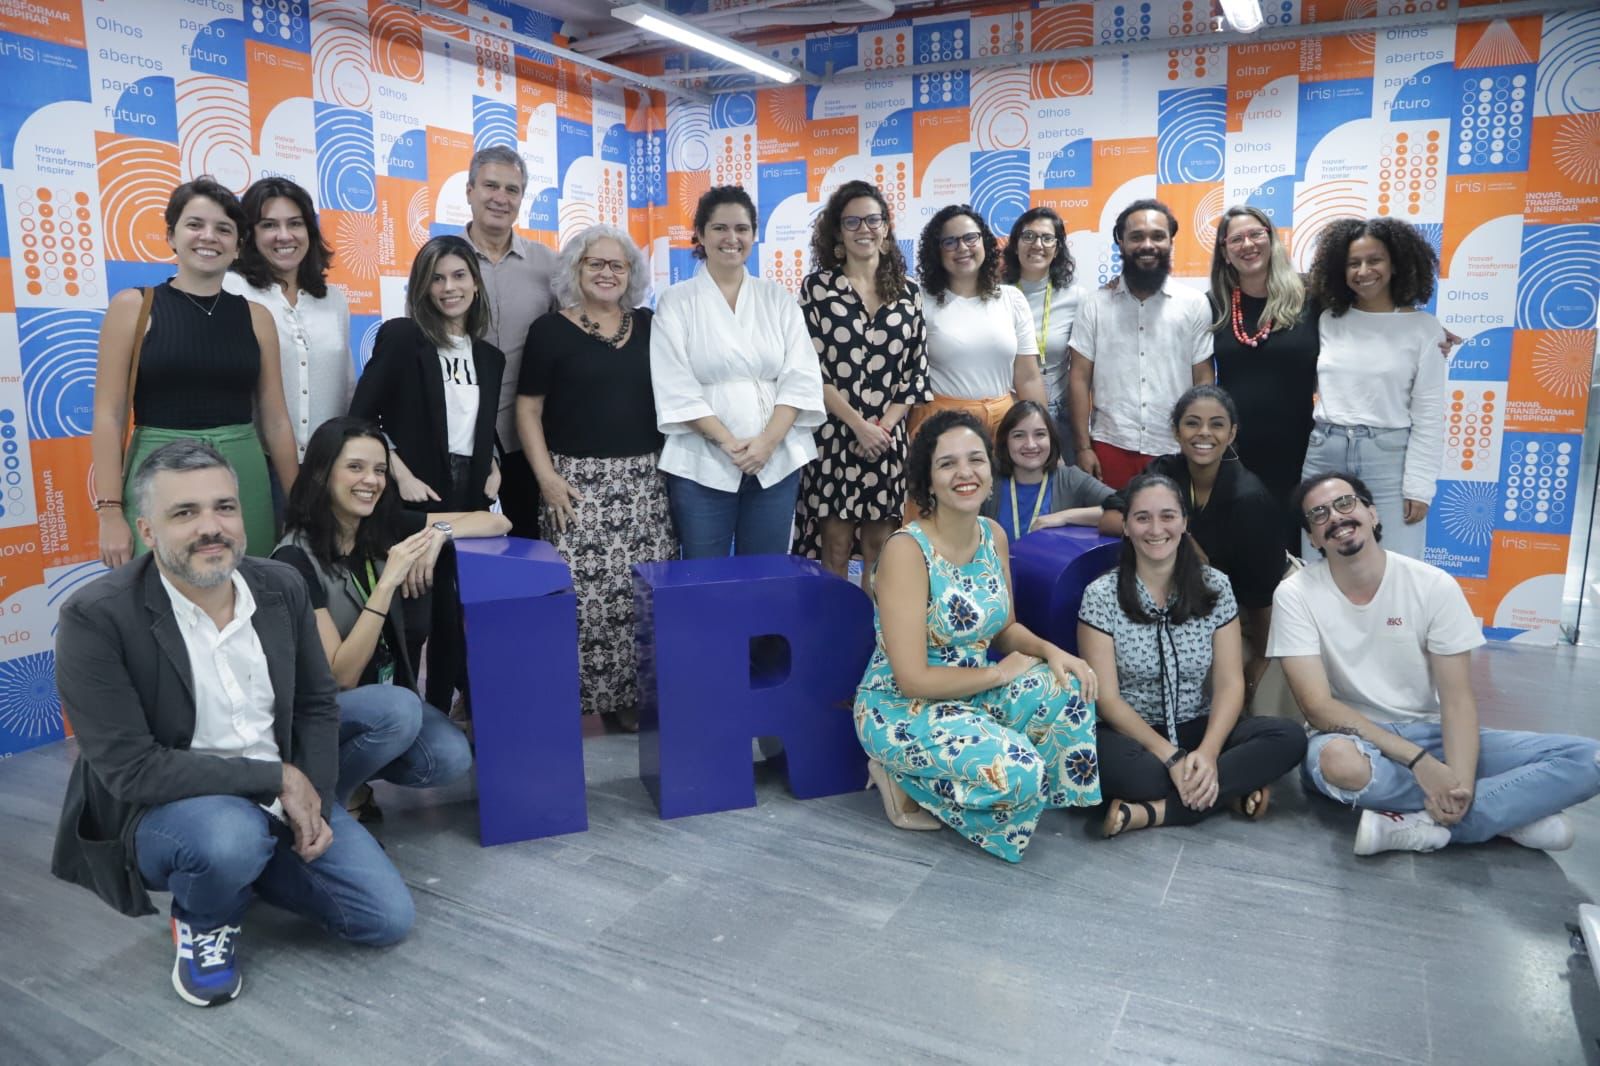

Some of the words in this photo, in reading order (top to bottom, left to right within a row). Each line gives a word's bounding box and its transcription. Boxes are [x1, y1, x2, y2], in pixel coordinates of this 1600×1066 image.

[96, 16, 144, 39] Olhos
[180, 18, 212, 35] para
[216, 28, 225, 38] o
[1387, 26, 1428, 40] Olhos
[1237, 45, 1259, 55] Um
[1264, 41, 1296, 52] novo
[99, 47, 163, 71] abertos
[182, 44, 227, 65] futuro
[254, 48, 276, 66] iris
[1385, 51, 1444, 64] abertos
[1236, 65, 1271, 77] olhar
[102, 77, 139, 95] para
[143, 86, 153, 97] o
[1384, 76, 1416, 88] para
[1422, 75, 1431, 84] o
[378, 86, 408, 102] Olhos
[1236, 90, 1266, 100] para
[1270, 88, 1278, 96] o
[1307, 87, 1331, 101] iris
[865, 98, 905, 110] abertos
[1384, 99, 1430, 111] futuro
[104, 106, 156, 125] futuro
[380, 110, 419, 126] abertos
[1038, 109, 1071, 118] Olhos
[1235, 109, 1282, 120] mundo
[865, 118, 888, 129] para
[891, 118, 898, 126] o
[813, 129, 829, 138] Um
[832, 127, 856, 136] novo
[1038, 128, 1084, 139] abertos
[381, 133, 404, 146] para
[407, 138, 413, 146] o
[865, 136, 898, 148] futuro
[35, 144, 66, 156] Inovar
[813, 146, 839, 157] olhar
[1100, 146, 1121, 157] iris
[1234, 142, 1271, 152] Olhos
[1038, 150, 1064, 160] para
[36, 154, 95, 170] Transformar
[382, 154, 414, 169] futuro
[37, 164, 74, 177] Inspirar
[814, 166, 836, 177] para
[1038, 169, 1076, 179] futuro
[1234, 164, 1286, 175] abertos
[814, 184, 838, 194] mun
[1233, 187, 1262, 198] para
[1267, 187, 1275, 195] o
[1455, 181, 1481, 193] iris
[1060, 199, 1088, 207] novo
[1526, 196, 1598, 206] TRANSFORMAR
[921, 206, 941, 216] Olh
[1448, 290, 1489, 301] Olhos
[1445, 314, 1504, 324] abertos
[1481, 337, 1490, 346] o
[1449, 358, 1489, 369] uturo
[1502, 536, 1527, 549] iris
[0, 542, 36, 557] ovo
[1424, 546, 1448, 555] OVAR,
[1425, 553, 1480, 563] ANSFORMAR
[11, 603, 21, 613] o
[0, 630, 30, 645] ndo
